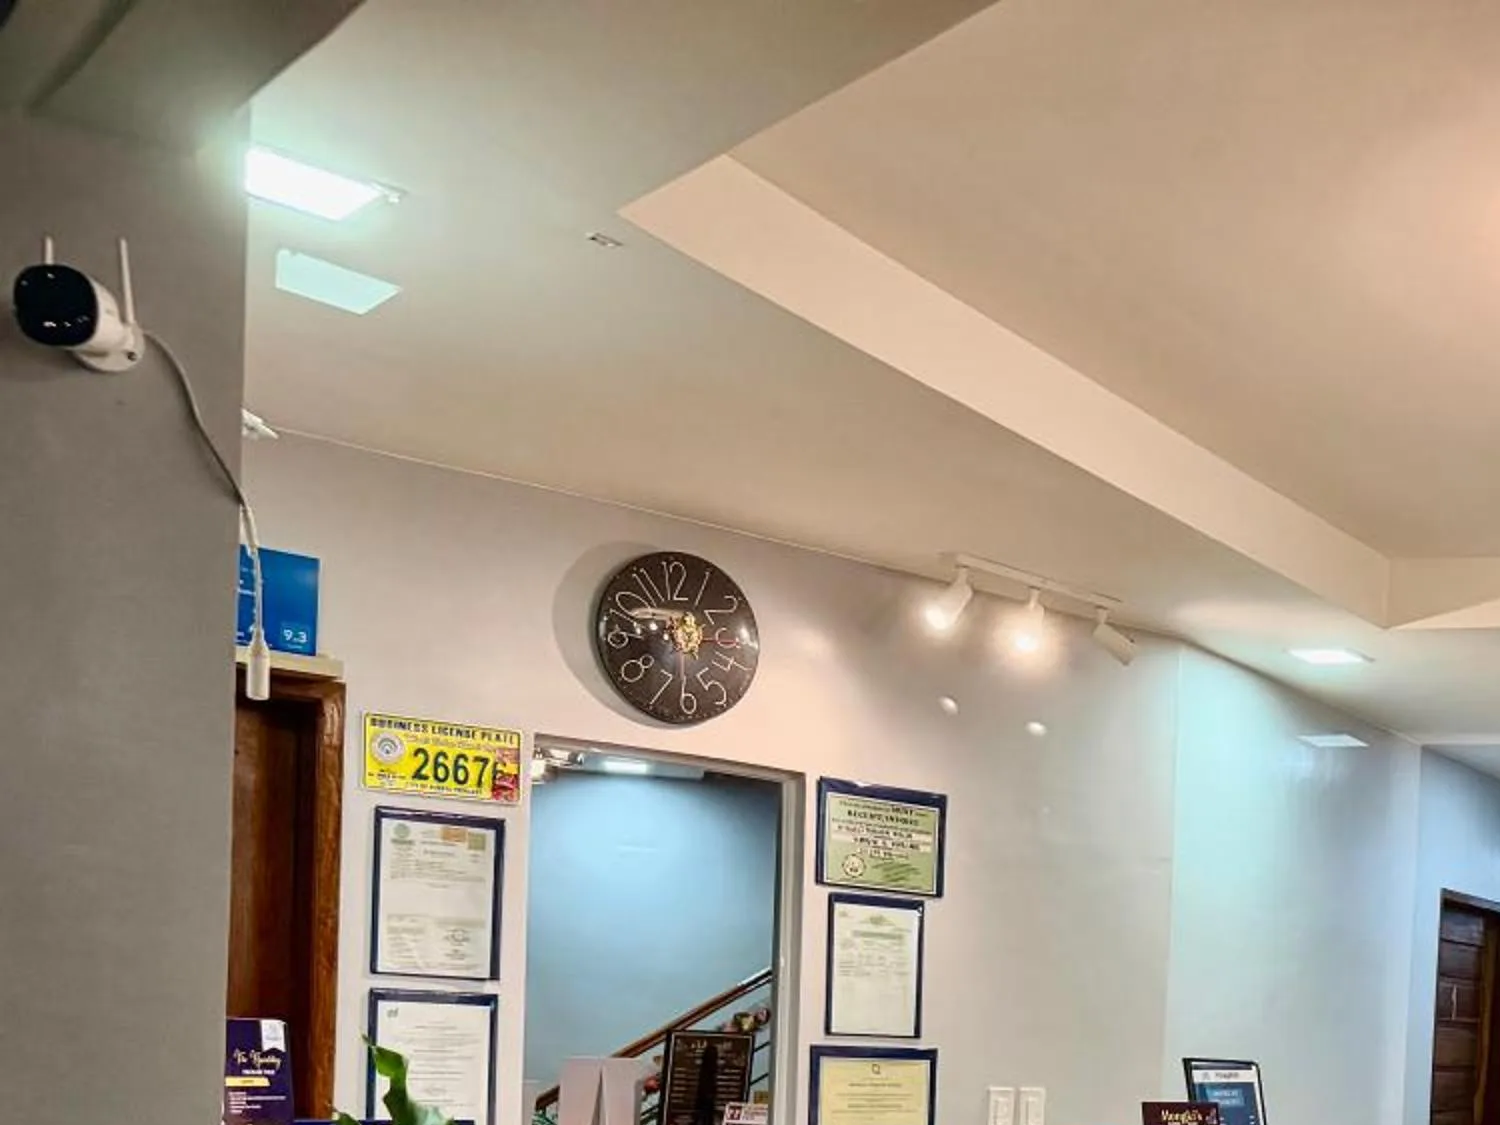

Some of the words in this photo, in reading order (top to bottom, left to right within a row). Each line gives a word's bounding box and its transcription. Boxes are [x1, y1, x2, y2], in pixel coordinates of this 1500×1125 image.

[631, 567, 665, 608] 11
[661, 561, 689, 601] 12
[694, 571, 711, 608] 1
[703, 595, 738, 625] 2
[620, 655, 654, 683] 8
[711, 651, 752, 671] 4
[650, 669, 673, 705] 7
[679, 675, 697, 714] 6
[696, 667, 727, 706] 5
[431, 725, 477, 739] LICENSE
